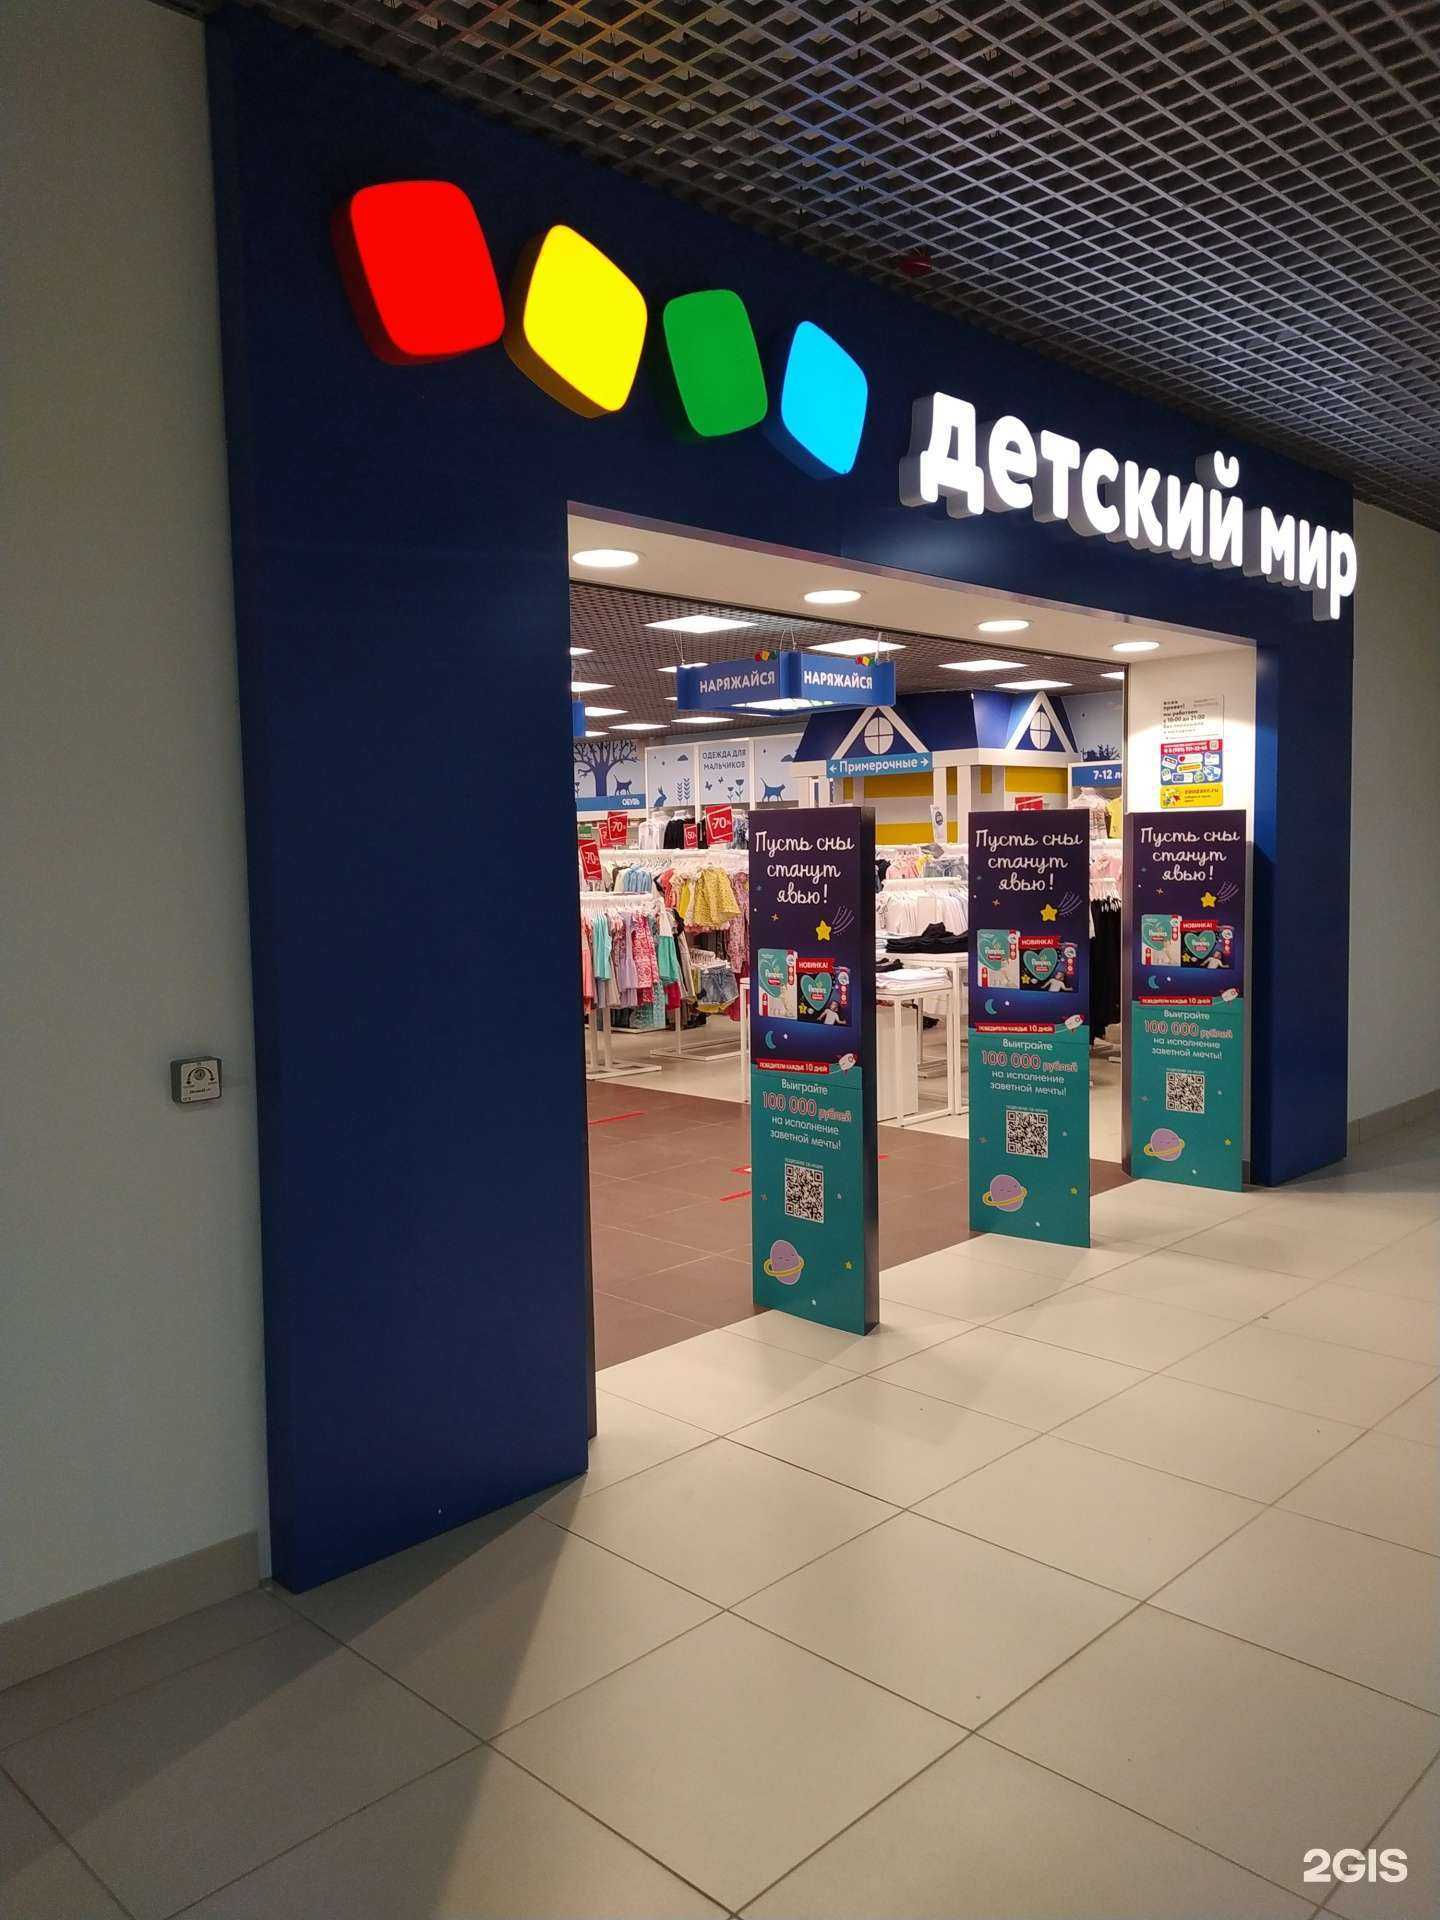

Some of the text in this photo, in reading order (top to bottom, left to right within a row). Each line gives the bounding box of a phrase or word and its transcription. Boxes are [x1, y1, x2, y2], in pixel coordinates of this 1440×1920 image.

[1260, 505, 1358, 621] мир
[700, 670, 775, 693] НАРЯЖАЙСЯ
[803, 670, 873, 690] НАРЯЖАЙСЯ
[702, 750, 732, 760] ОДЕЖДА
[703, 761, 746, 770] МАЛЬЧИКОВ
[839, 758, 918, 775] Примерочные
[1093, 769, 1113, 780] 7-12
[755, 831, 855, 858] Пусть сны
[976, 829, 1083, 852] Пусть сны
[1141, 827, 1240, 847] Пусть сны
[988, 857, 1068, 874] станут
[1152, 850, 1227, 866] станут
[767, 864, 841, 884] станут
[1021, 938, 1054, 946] НОВИНКА!
[799, 961, 829, 969] НОВИНКА!
[1163, 1009, 1210, 1020] Выиграйте
[1029, 1023, 1037, 1031] 10
[1144, 1019, 1168, 1034] 100
[1171, 1021, 1199, 1037] 000
[1002, 1038, 1053, 1051] Выиграйте
[1153, 1037, 1220, 1049] на исполнение
[982, 1050, 1007, 1066] 100
[1010, 1052, 1041, 1069] 000
[1151, 1047, 1190, 1057] заветной
[805, 1063, 813, 1071] 10
[992, 1070, 1065, 1084] на исполнение
[781, 1078, 828, 1095] Выиграйте
[990, 1081, 1067, 1097] заветной мечты!
[763, 1091, 785, 1112] 100
[789, 1095, 817, 1117] 000
[772, 1116, 840, 1136] на исполнение
[770, 1129, 841, 1151] заветной мечты!
